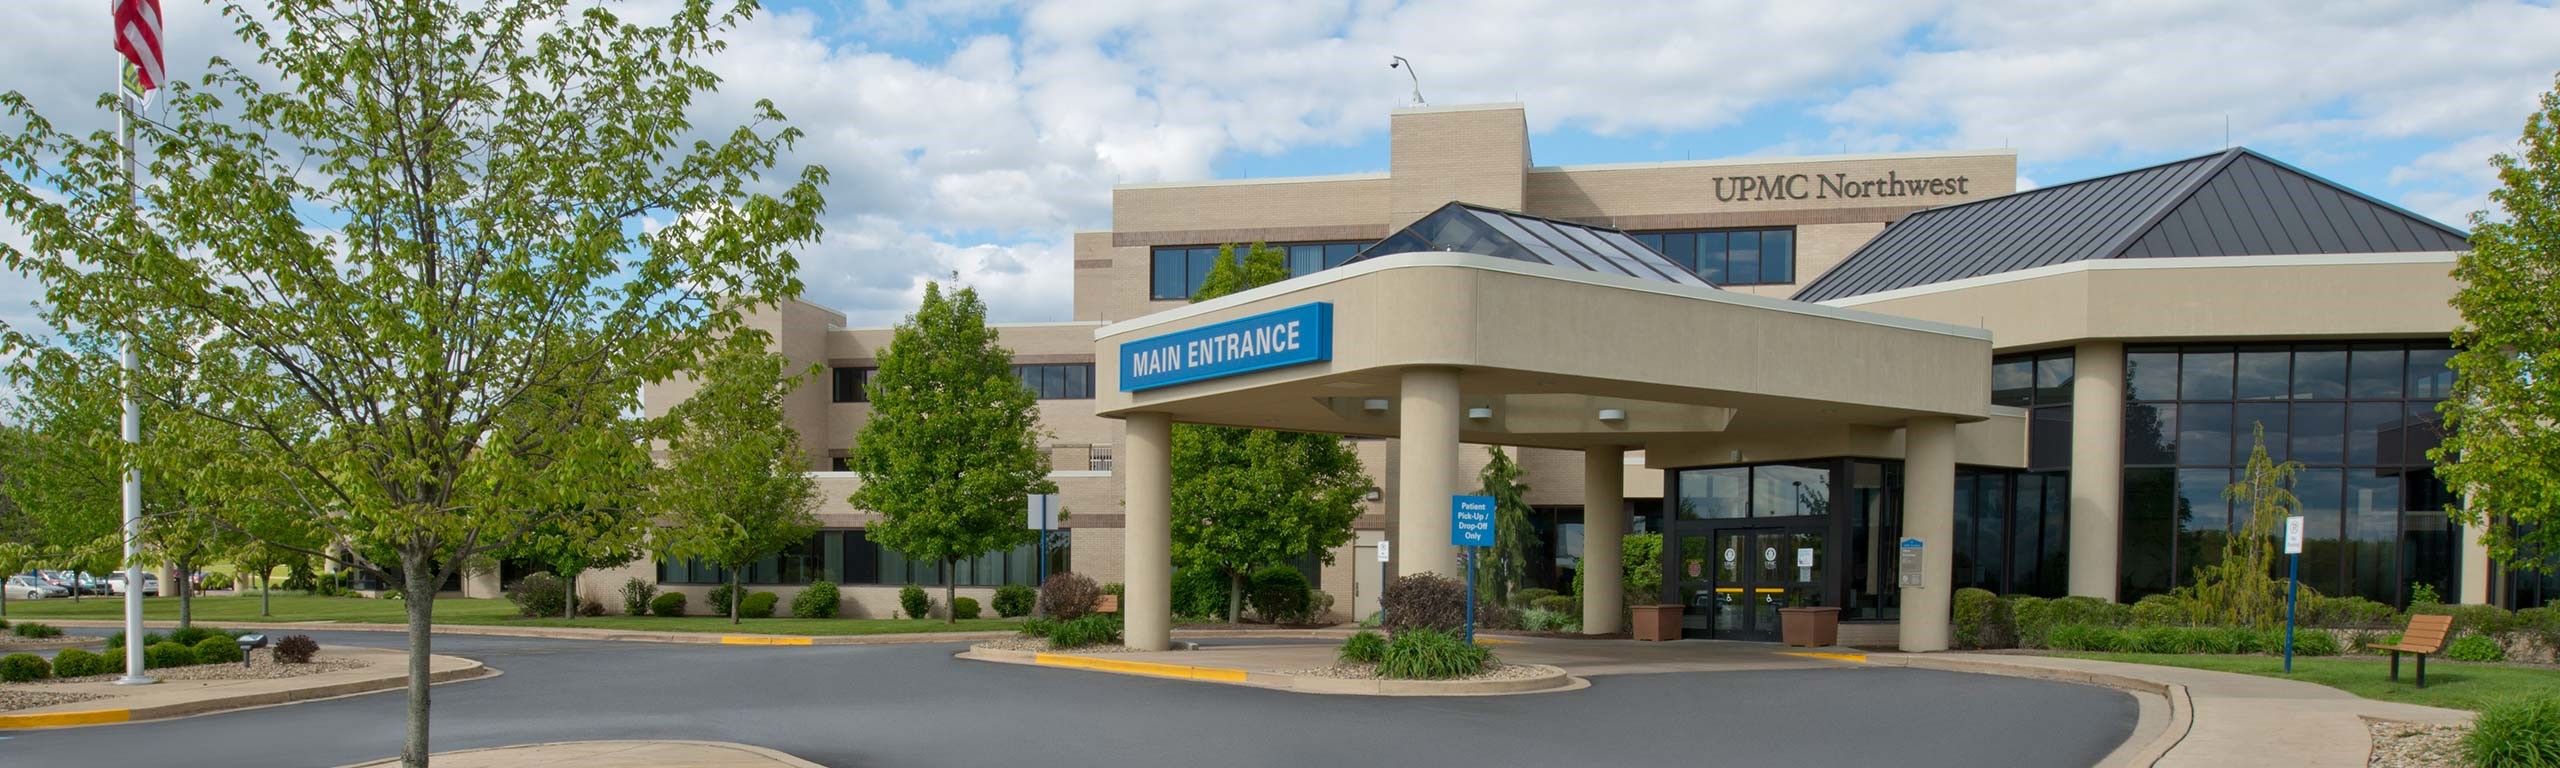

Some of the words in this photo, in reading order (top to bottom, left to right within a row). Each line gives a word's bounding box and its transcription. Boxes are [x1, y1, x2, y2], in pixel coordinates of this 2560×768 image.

[1712, 173, 1809, 202] UPMC
[1816, 170, 1969, 199] Northwest
[1133, 344, 1181, 378] MAIN
[1187, 320, 1300, 368] ENTRANCE
[1461, 502, 1486, 511] Patient
[1457, 512, 1484, 521] Pick-Up
[1458, 522, 1488, 531] Drop-Off
[1464, 532, 1481, 541] Only
